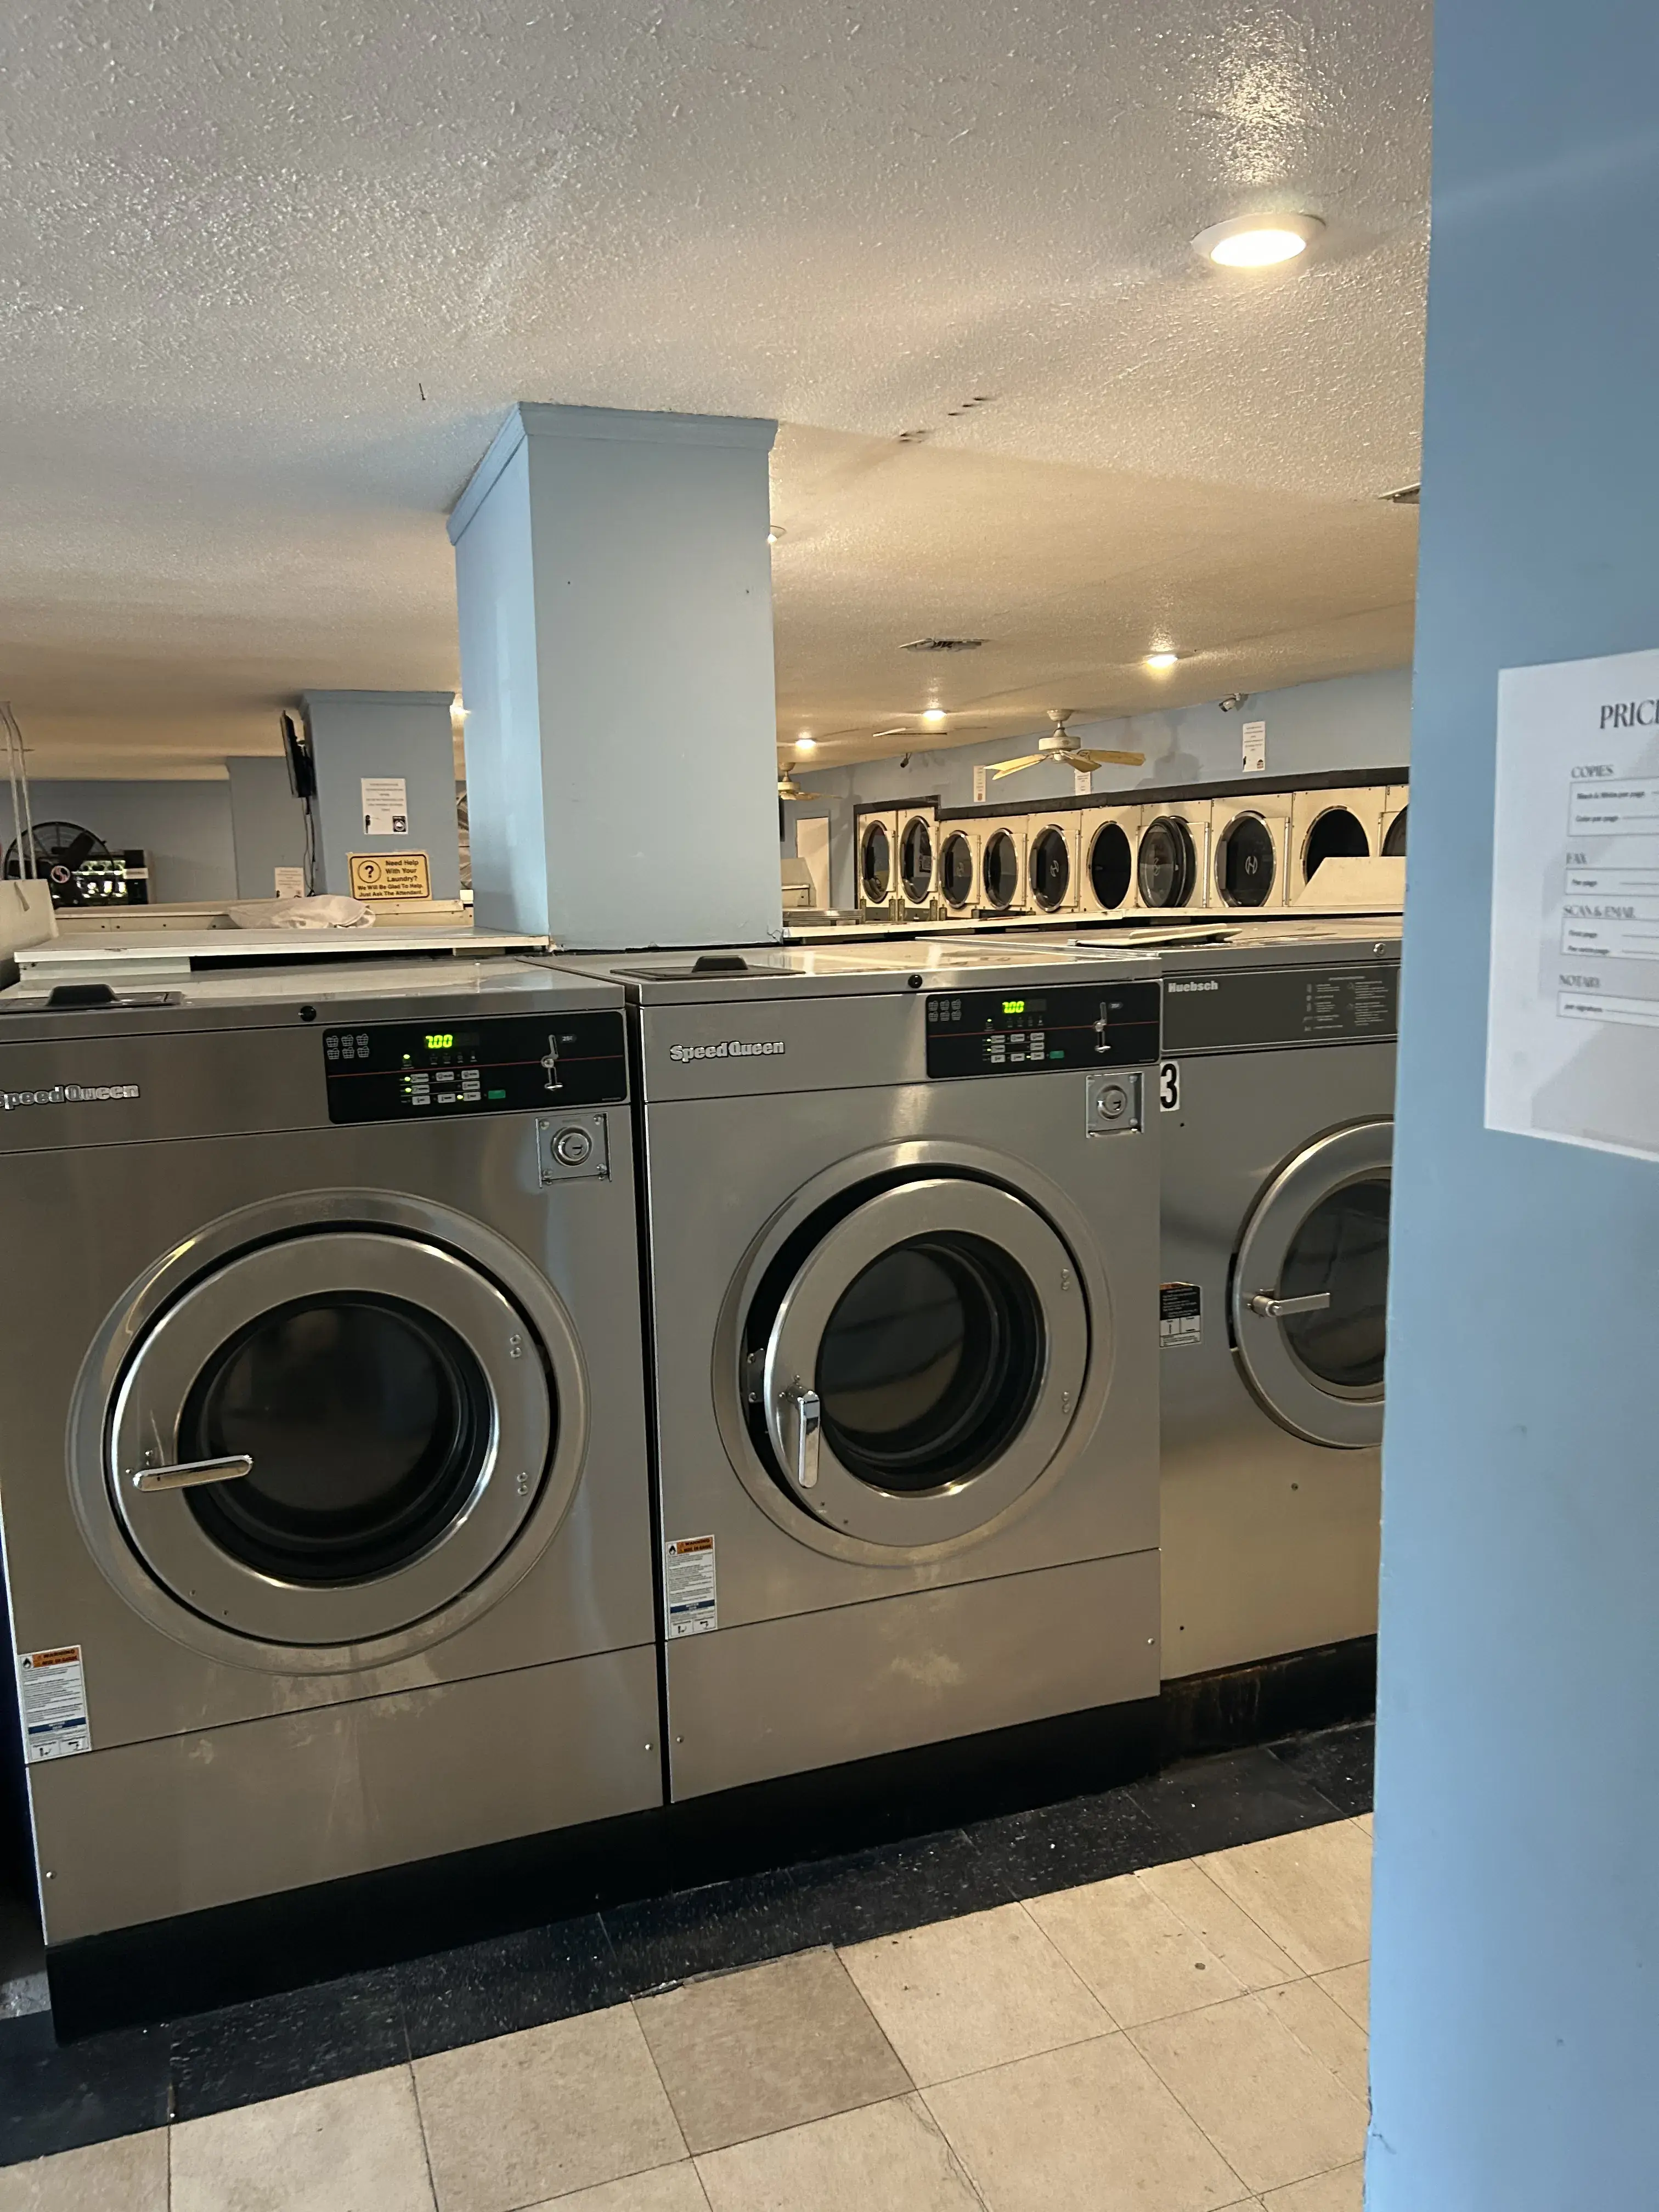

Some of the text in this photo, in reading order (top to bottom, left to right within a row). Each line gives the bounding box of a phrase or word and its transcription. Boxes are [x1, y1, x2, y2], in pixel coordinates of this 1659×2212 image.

[1167, 980, 1218, 993] Huebsch
[669, 1041, 785, 1064] Speed Queen
[64, 1084, 139, 1102] Queen
[1160, 1063, 1177, 1109] 3
